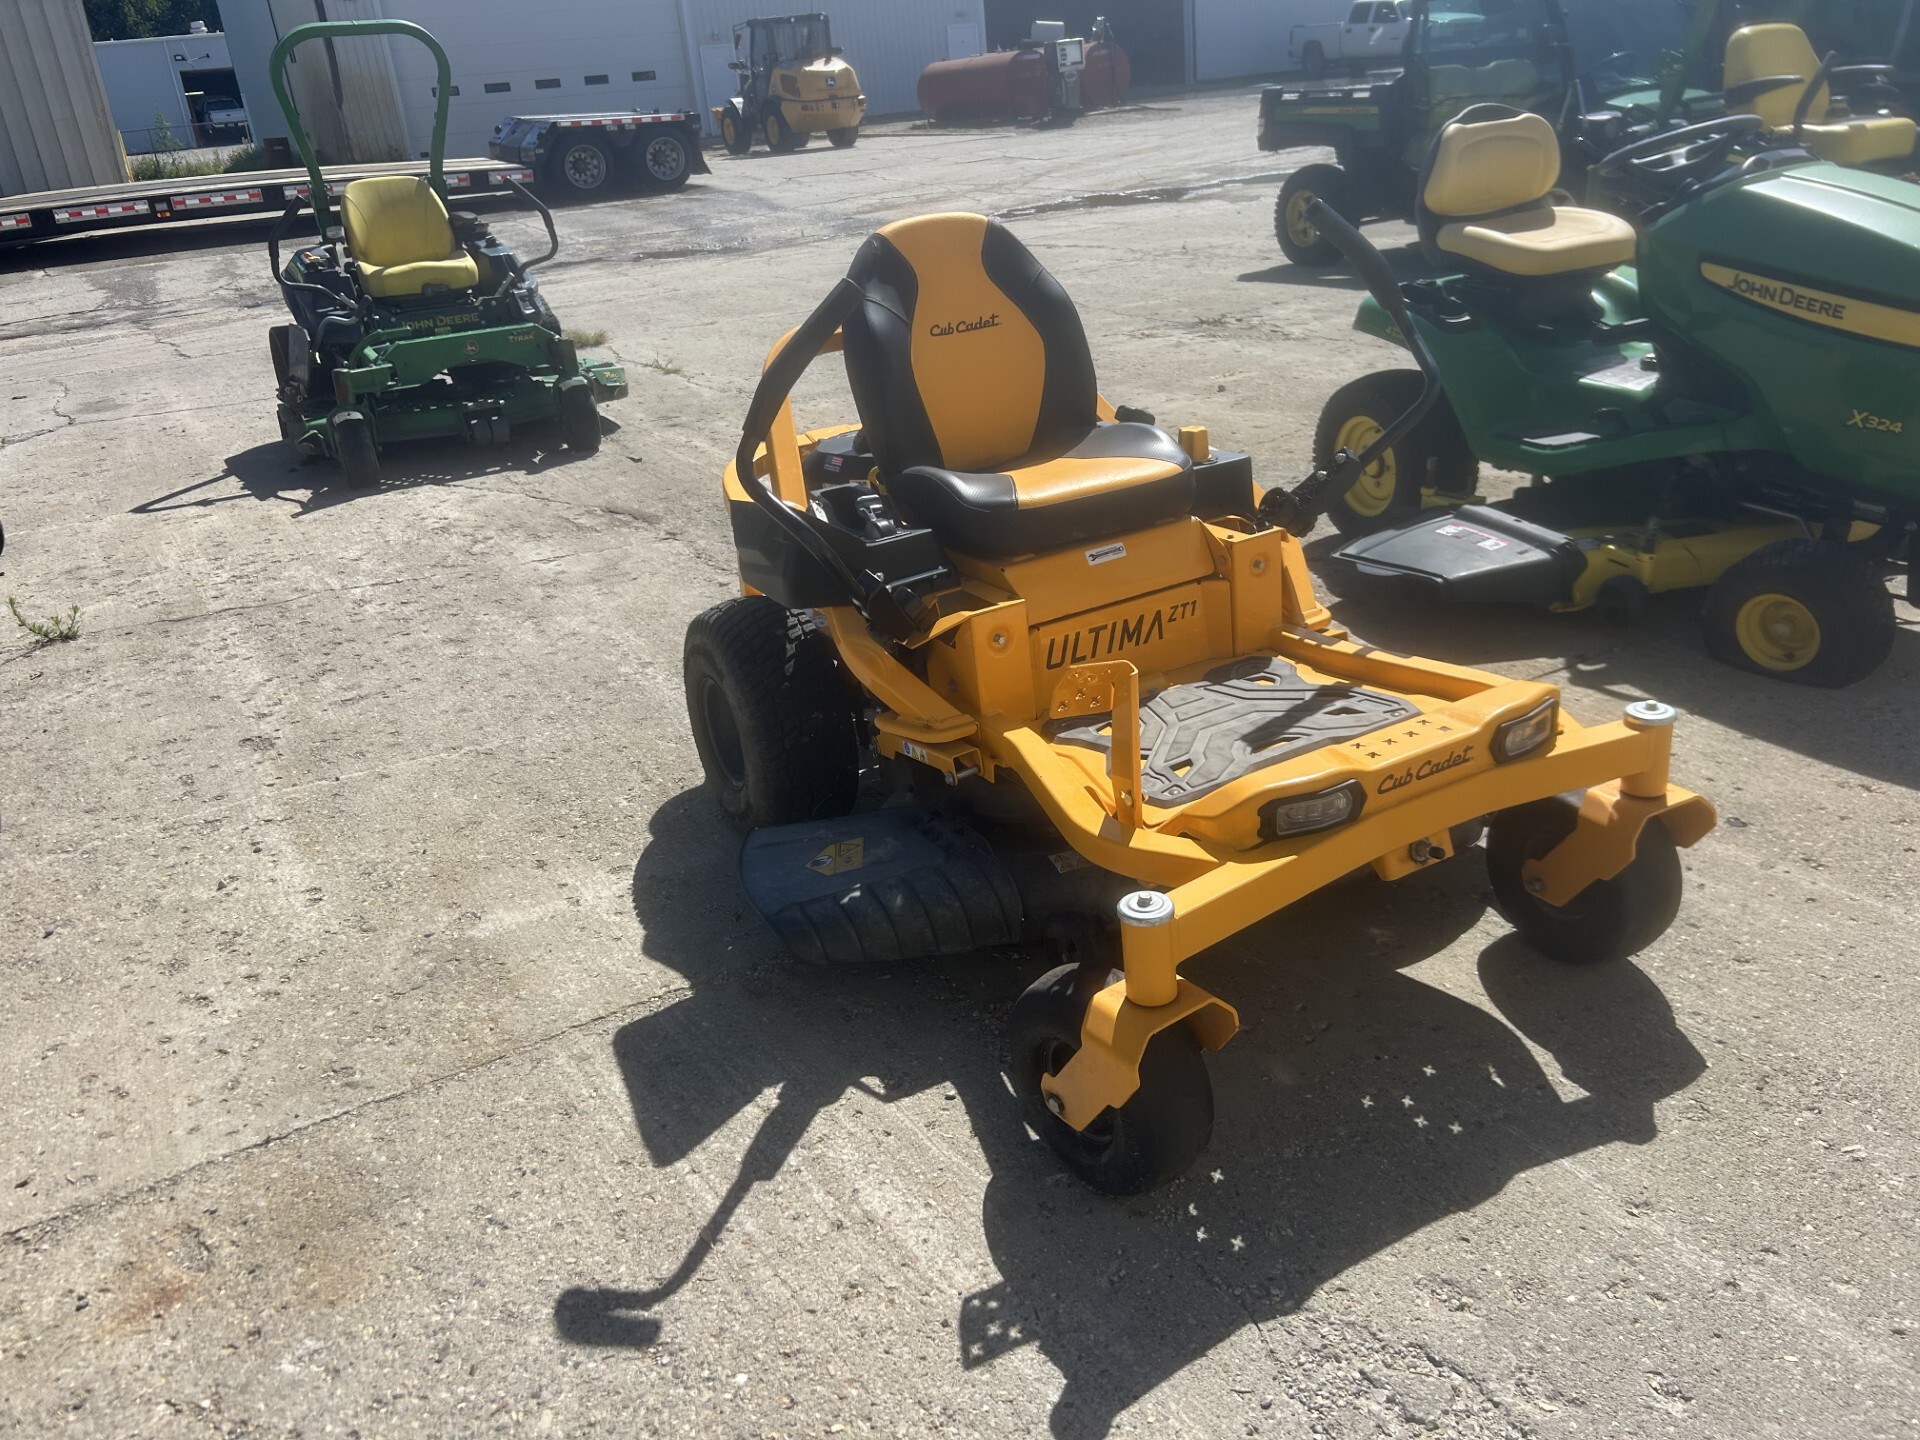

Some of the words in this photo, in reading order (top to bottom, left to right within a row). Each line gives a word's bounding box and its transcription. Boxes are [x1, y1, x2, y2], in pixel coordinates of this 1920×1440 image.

[1727, 273, 1778, 302] JOHN
[1779, 286, 1846, 320] DEERE
[401, 319, 434, 330] JOHN
[436, 312, 480, 326] DEERE
[930, 322, 955, 336] Cub
[956, 313, 1000, 333] Cadet
[1844, 409, 1903, 433] X324
[1046, 609, 1164, 670] ULTIMA
[1167, 600, 1197, 623] ZT1
[1377, 767, 1413, 794] Cub
[1415, 745, 1474, 780] Cadet
